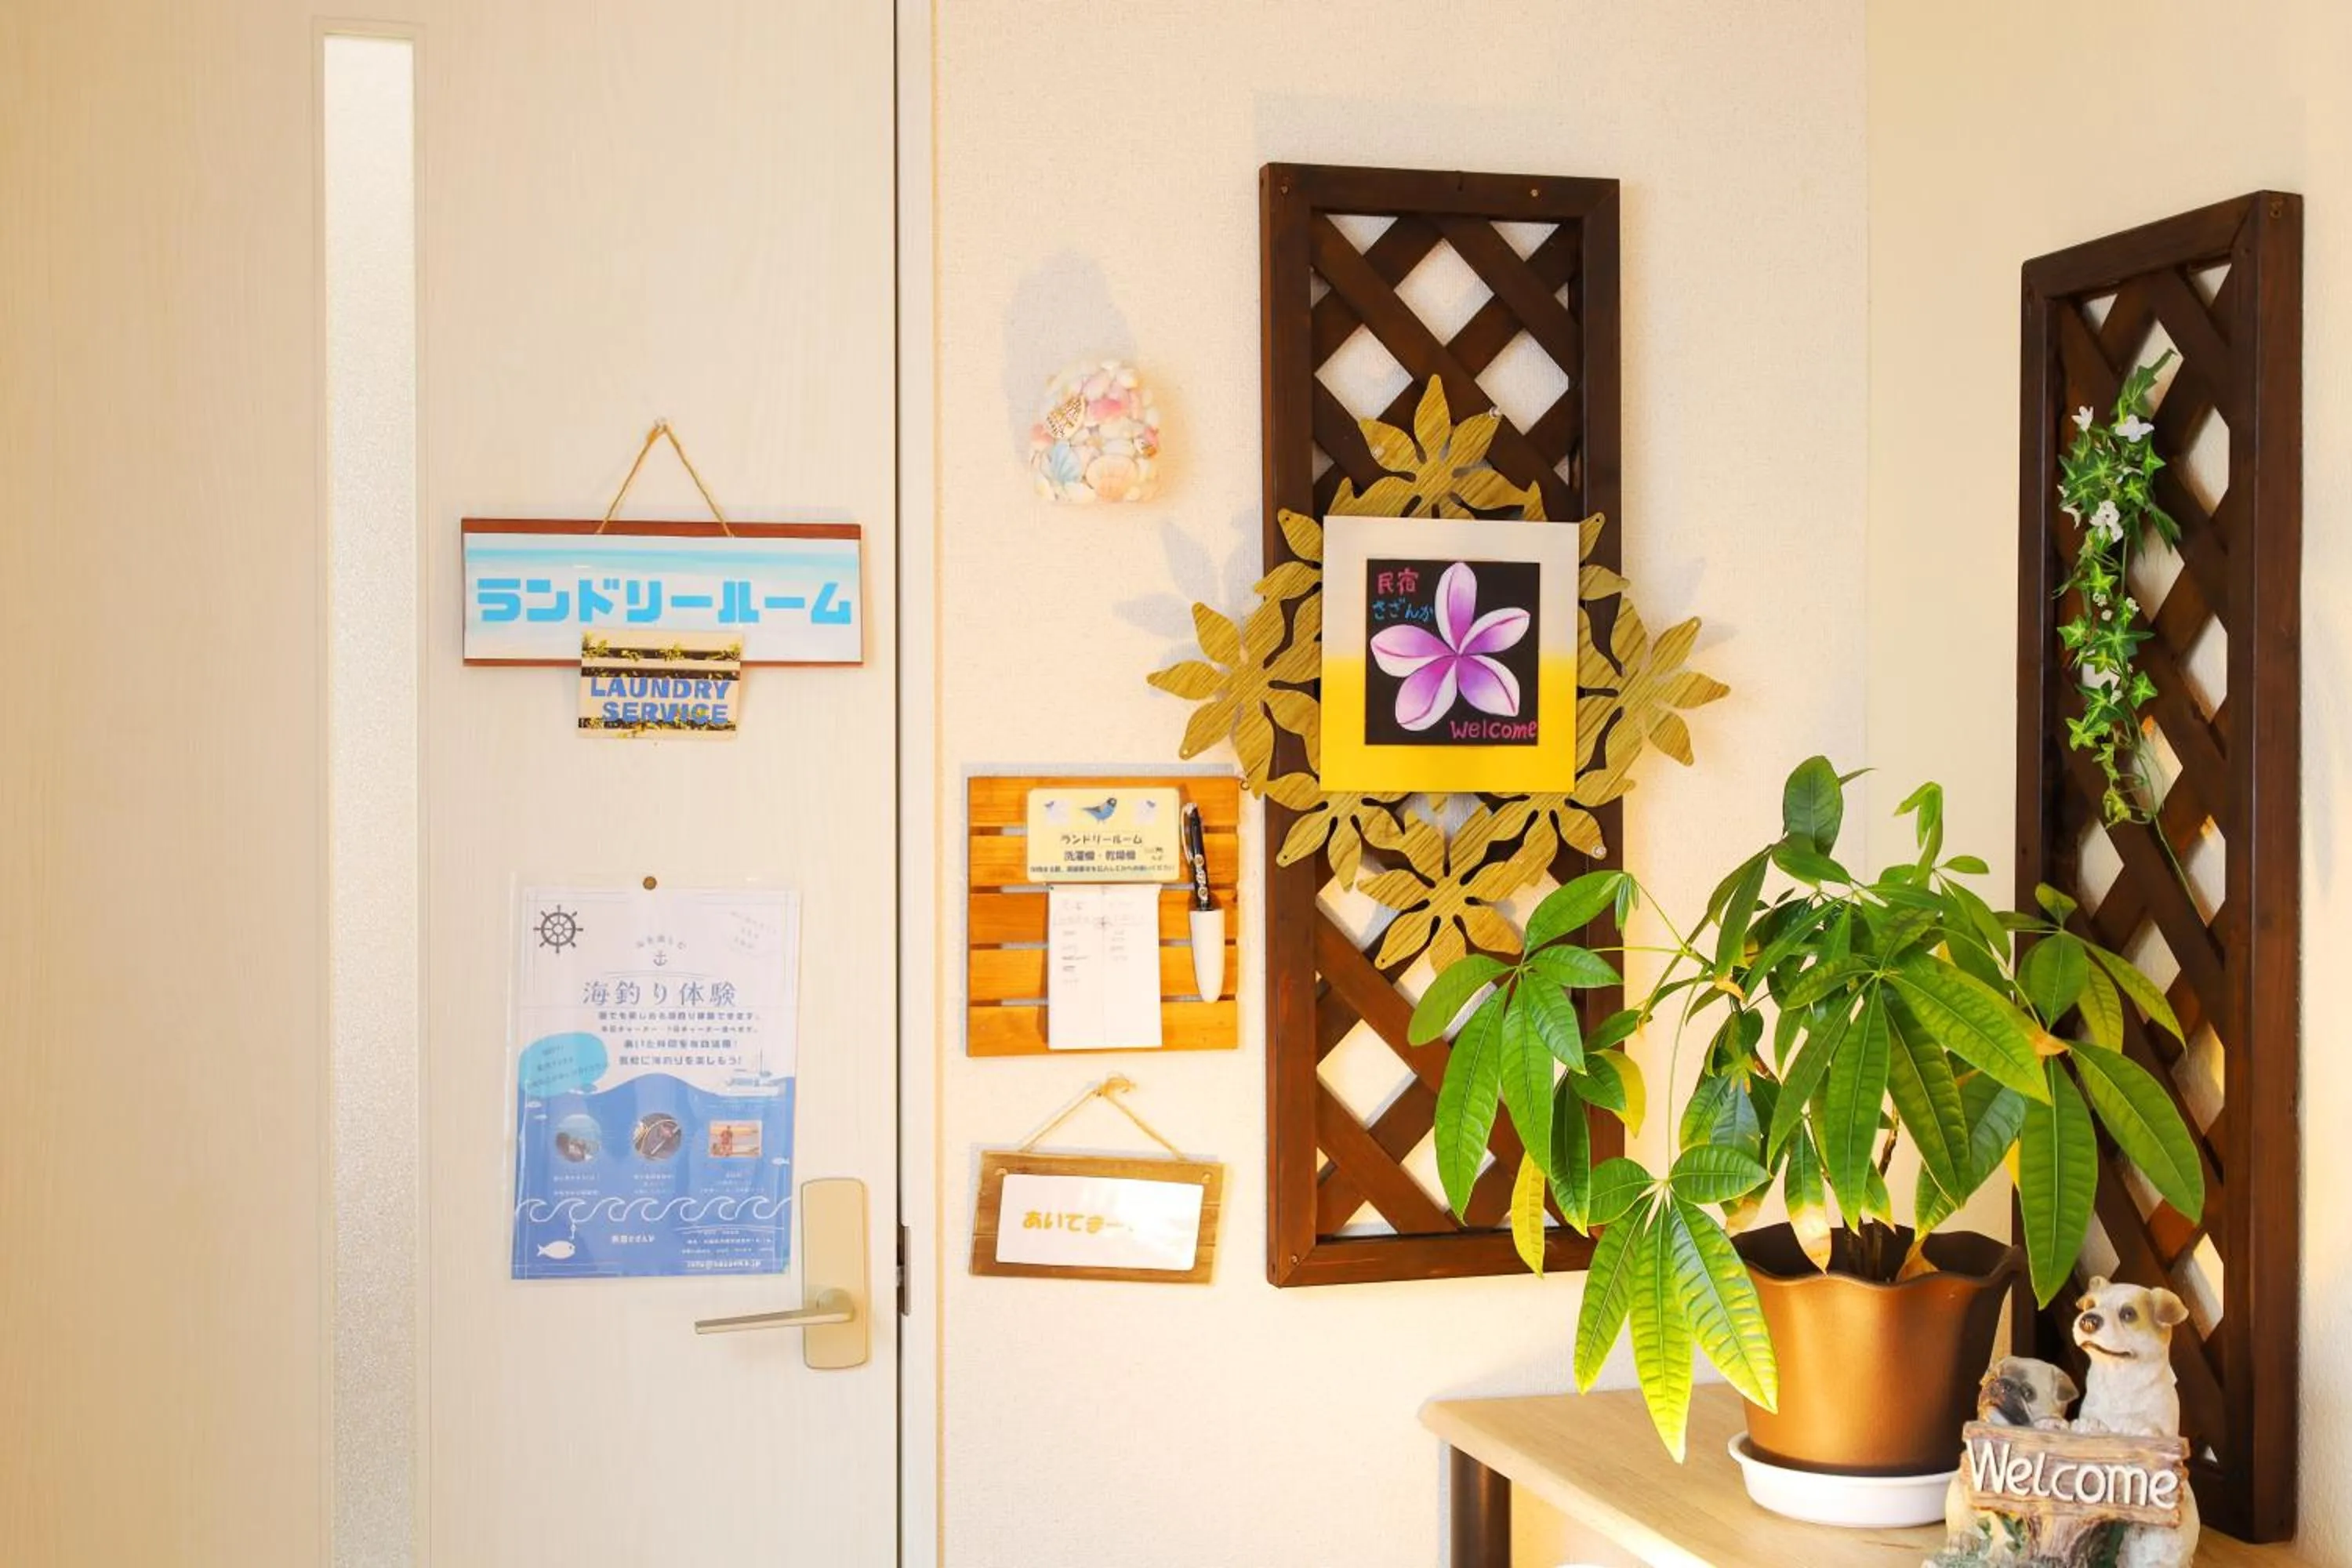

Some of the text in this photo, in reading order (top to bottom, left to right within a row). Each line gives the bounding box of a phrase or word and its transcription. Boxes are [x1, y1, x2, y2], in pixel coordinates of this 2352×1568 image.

[1377, 567, 1419, 595] 民宿
[477, 577, 852, 625] ランドリールーム
[1371, 597, 1434, 622] さざんか
[590, 676, 731, 700] LAUNDRY
[601, 700, 729, 724] SERVICE
[1450, 720, 1538, 739] Welcome
[1061, 833, 1143, 845] ランドリールーム
[583, 980, 738, 1007] 海釣り体験
[1965, 1439, 2180, 1510] Welcome
